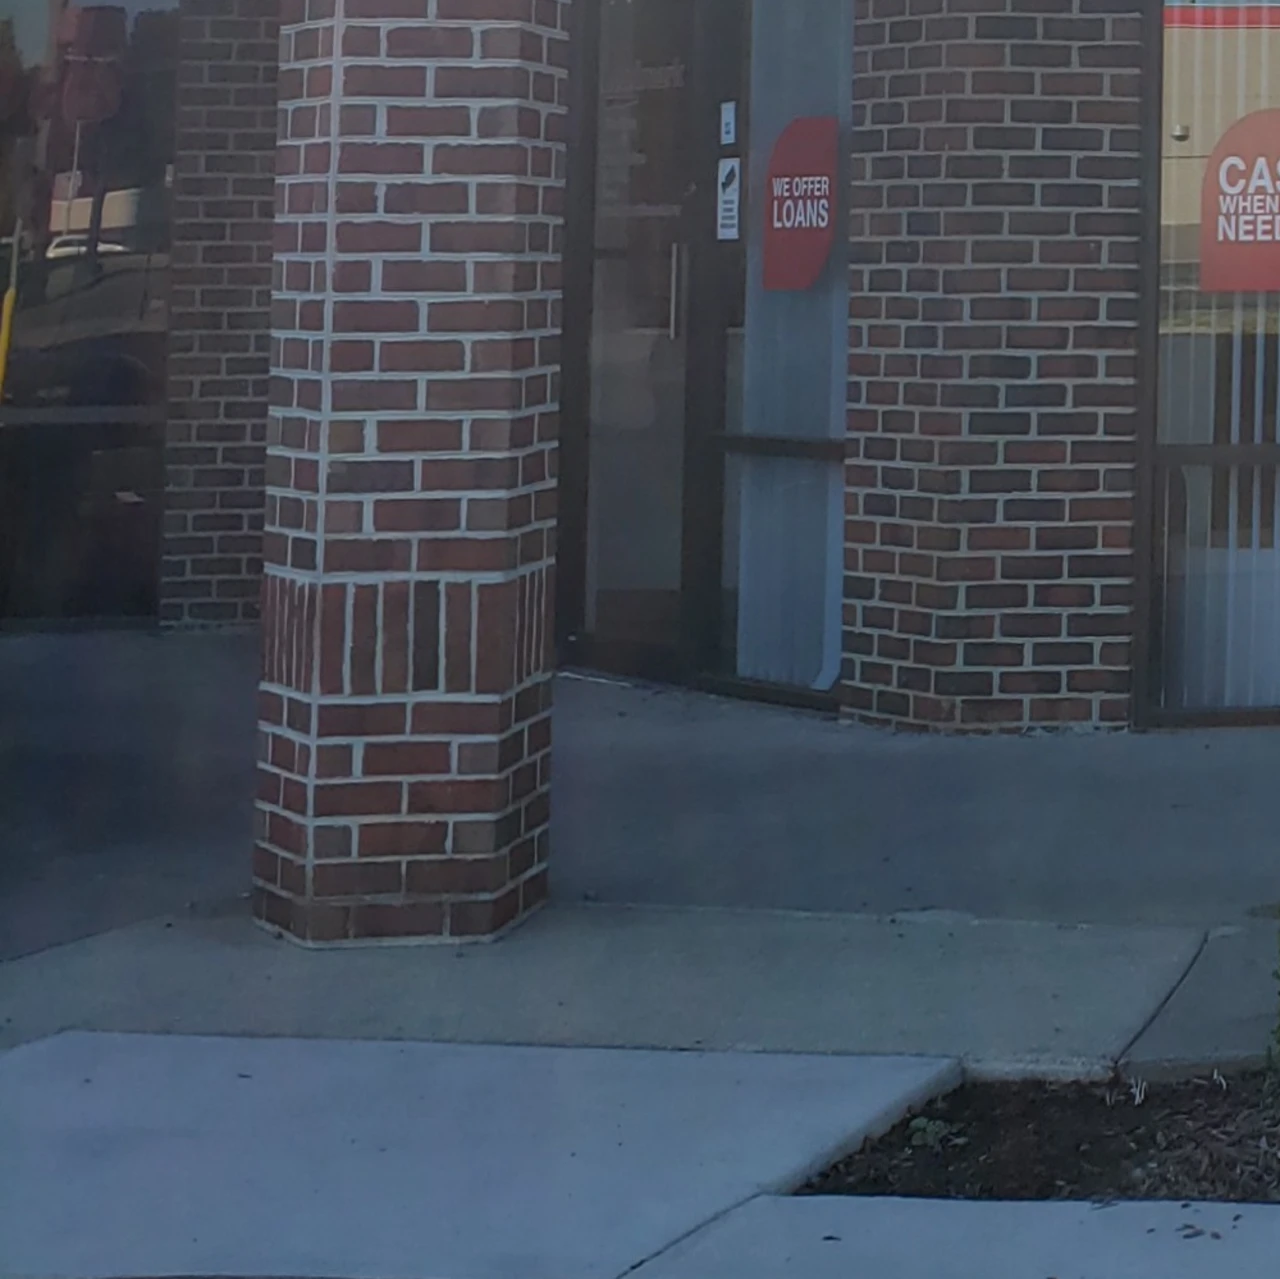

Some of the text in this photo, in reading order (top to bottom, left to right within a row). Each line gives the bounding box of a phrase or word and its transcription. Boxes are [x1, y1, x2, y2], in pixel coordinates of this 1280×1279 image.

[772, 176, 829, 197] WE OFFER
[773, 198, 829, 228] LOANS
[1219, 194, 1280, 214] WHEN
